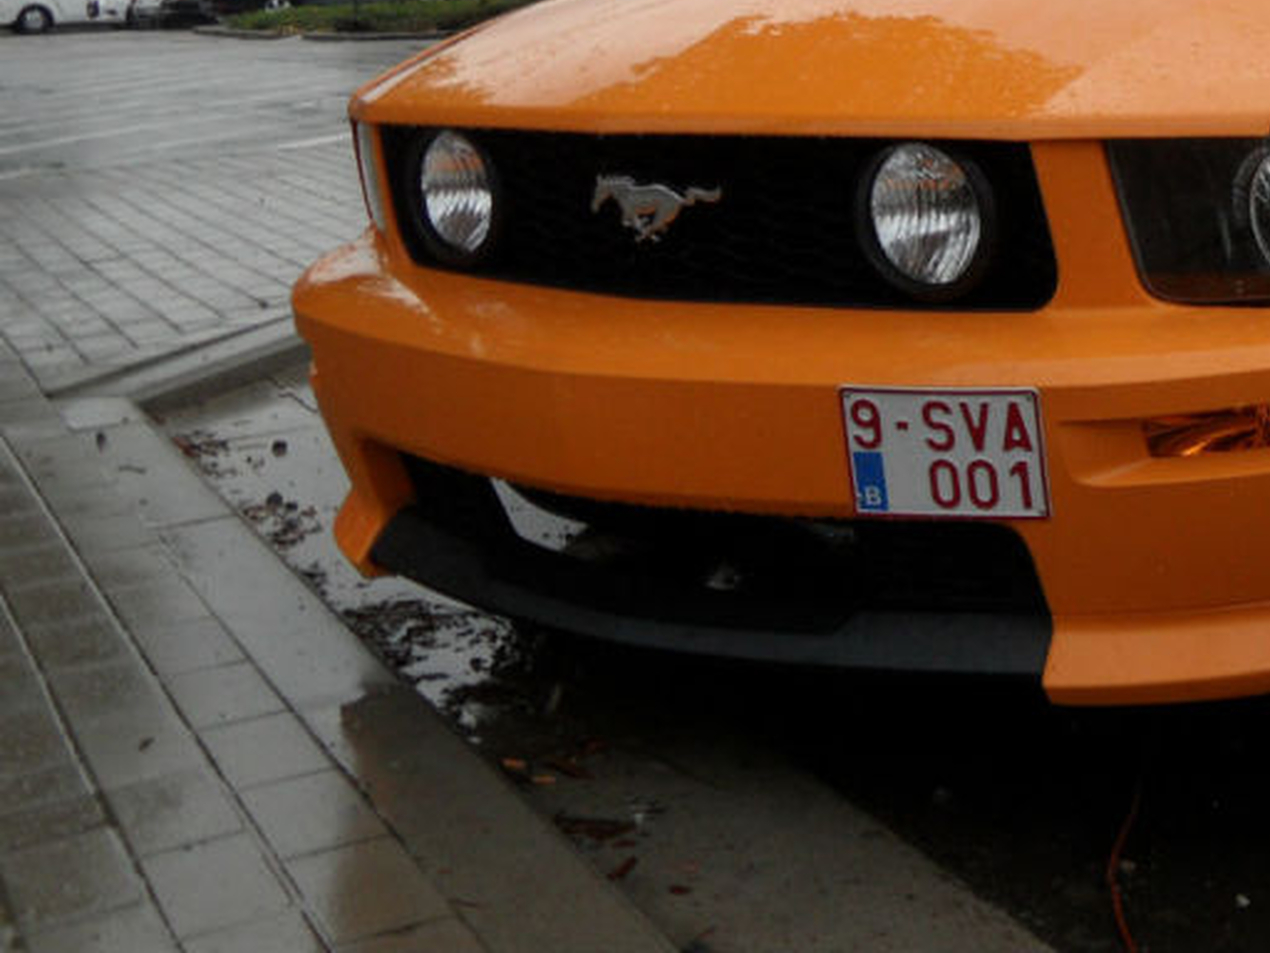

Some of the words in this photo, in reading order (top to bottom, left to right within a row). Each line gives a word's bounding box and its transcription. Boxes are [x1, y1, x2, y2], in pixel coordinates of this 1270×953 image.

[851, 398, 1033, 453] 9-SVA
[864, 485, 883, 506] B
[928, 458, 1034, 510] 001
